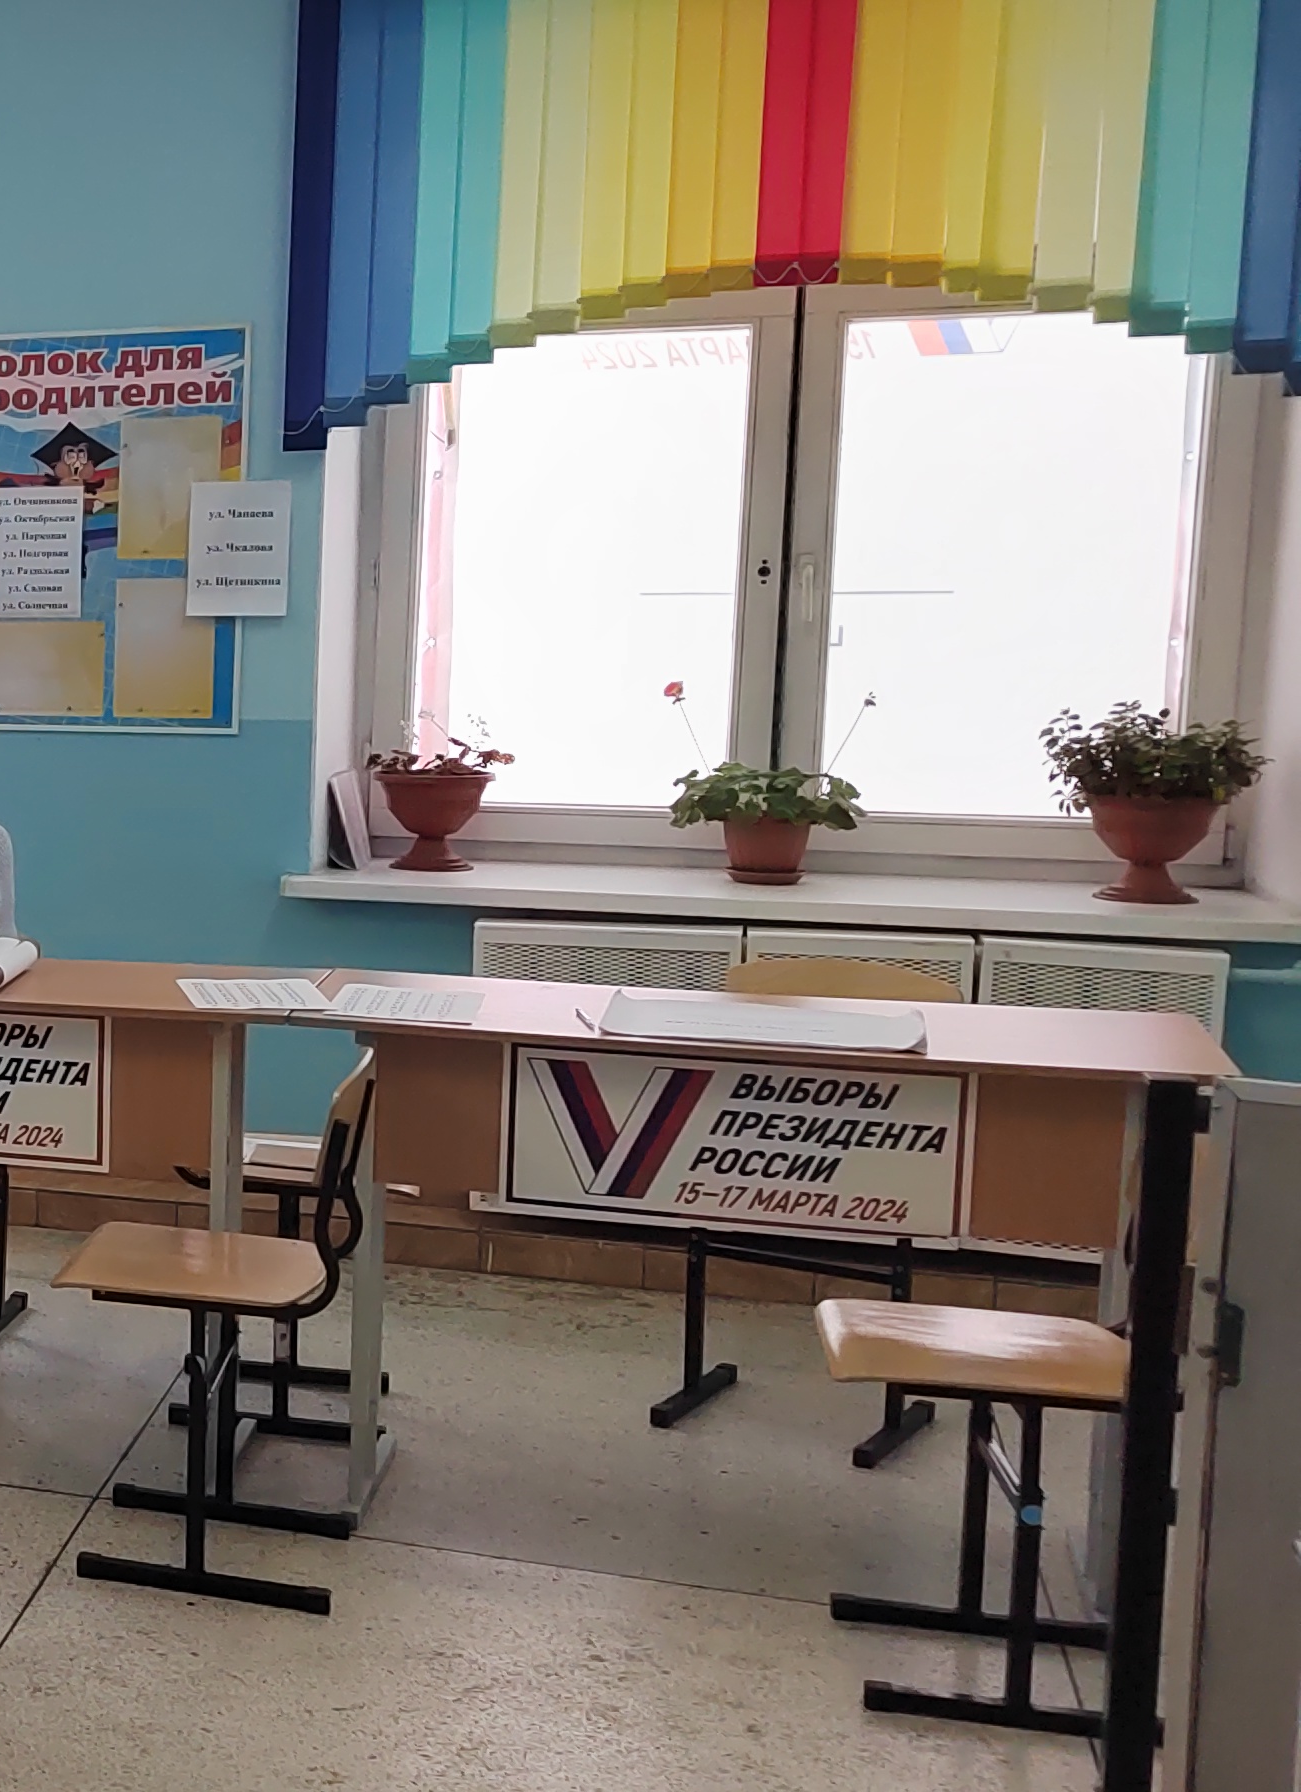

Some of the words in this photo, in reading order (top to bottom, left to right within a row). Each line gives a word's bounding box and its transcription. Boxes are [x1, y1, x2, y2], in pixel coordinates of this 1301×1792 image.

[114, 346, 204, 379] для
[14, 514, 75, 525] Октябрьская
[208, 511, 224, 521] ул.
[228, 508, 274, 518] Чапаева
[5, 534, 17, 542] ул.
[206, 545, 223, 554] ул.
[226, 543, 273, 552] Чкалова
[3, 551, 17, 559] ул.
[1, 569, 14, 577] ул.
[196, 579, 212, 588] ул.
[216, 577, 281, 587] Щетинкина
[8, 586, 21, 594] ул.
[2, 603, 16, 611] ул.
[18, 601, 68, 609] Солнечная
[729, 1073, 900, 1110] ВЫБОРЫ
[12, 1124, 65, 1149] 2024
[709, 1109, 948, 1154] ПРЕЗИДЕНТА
[689, 1146, 843, 1184] РОССИИ
[747, 1187, 840, 1218] МАРТА
[842, 1196, 910, 1224] 2024
